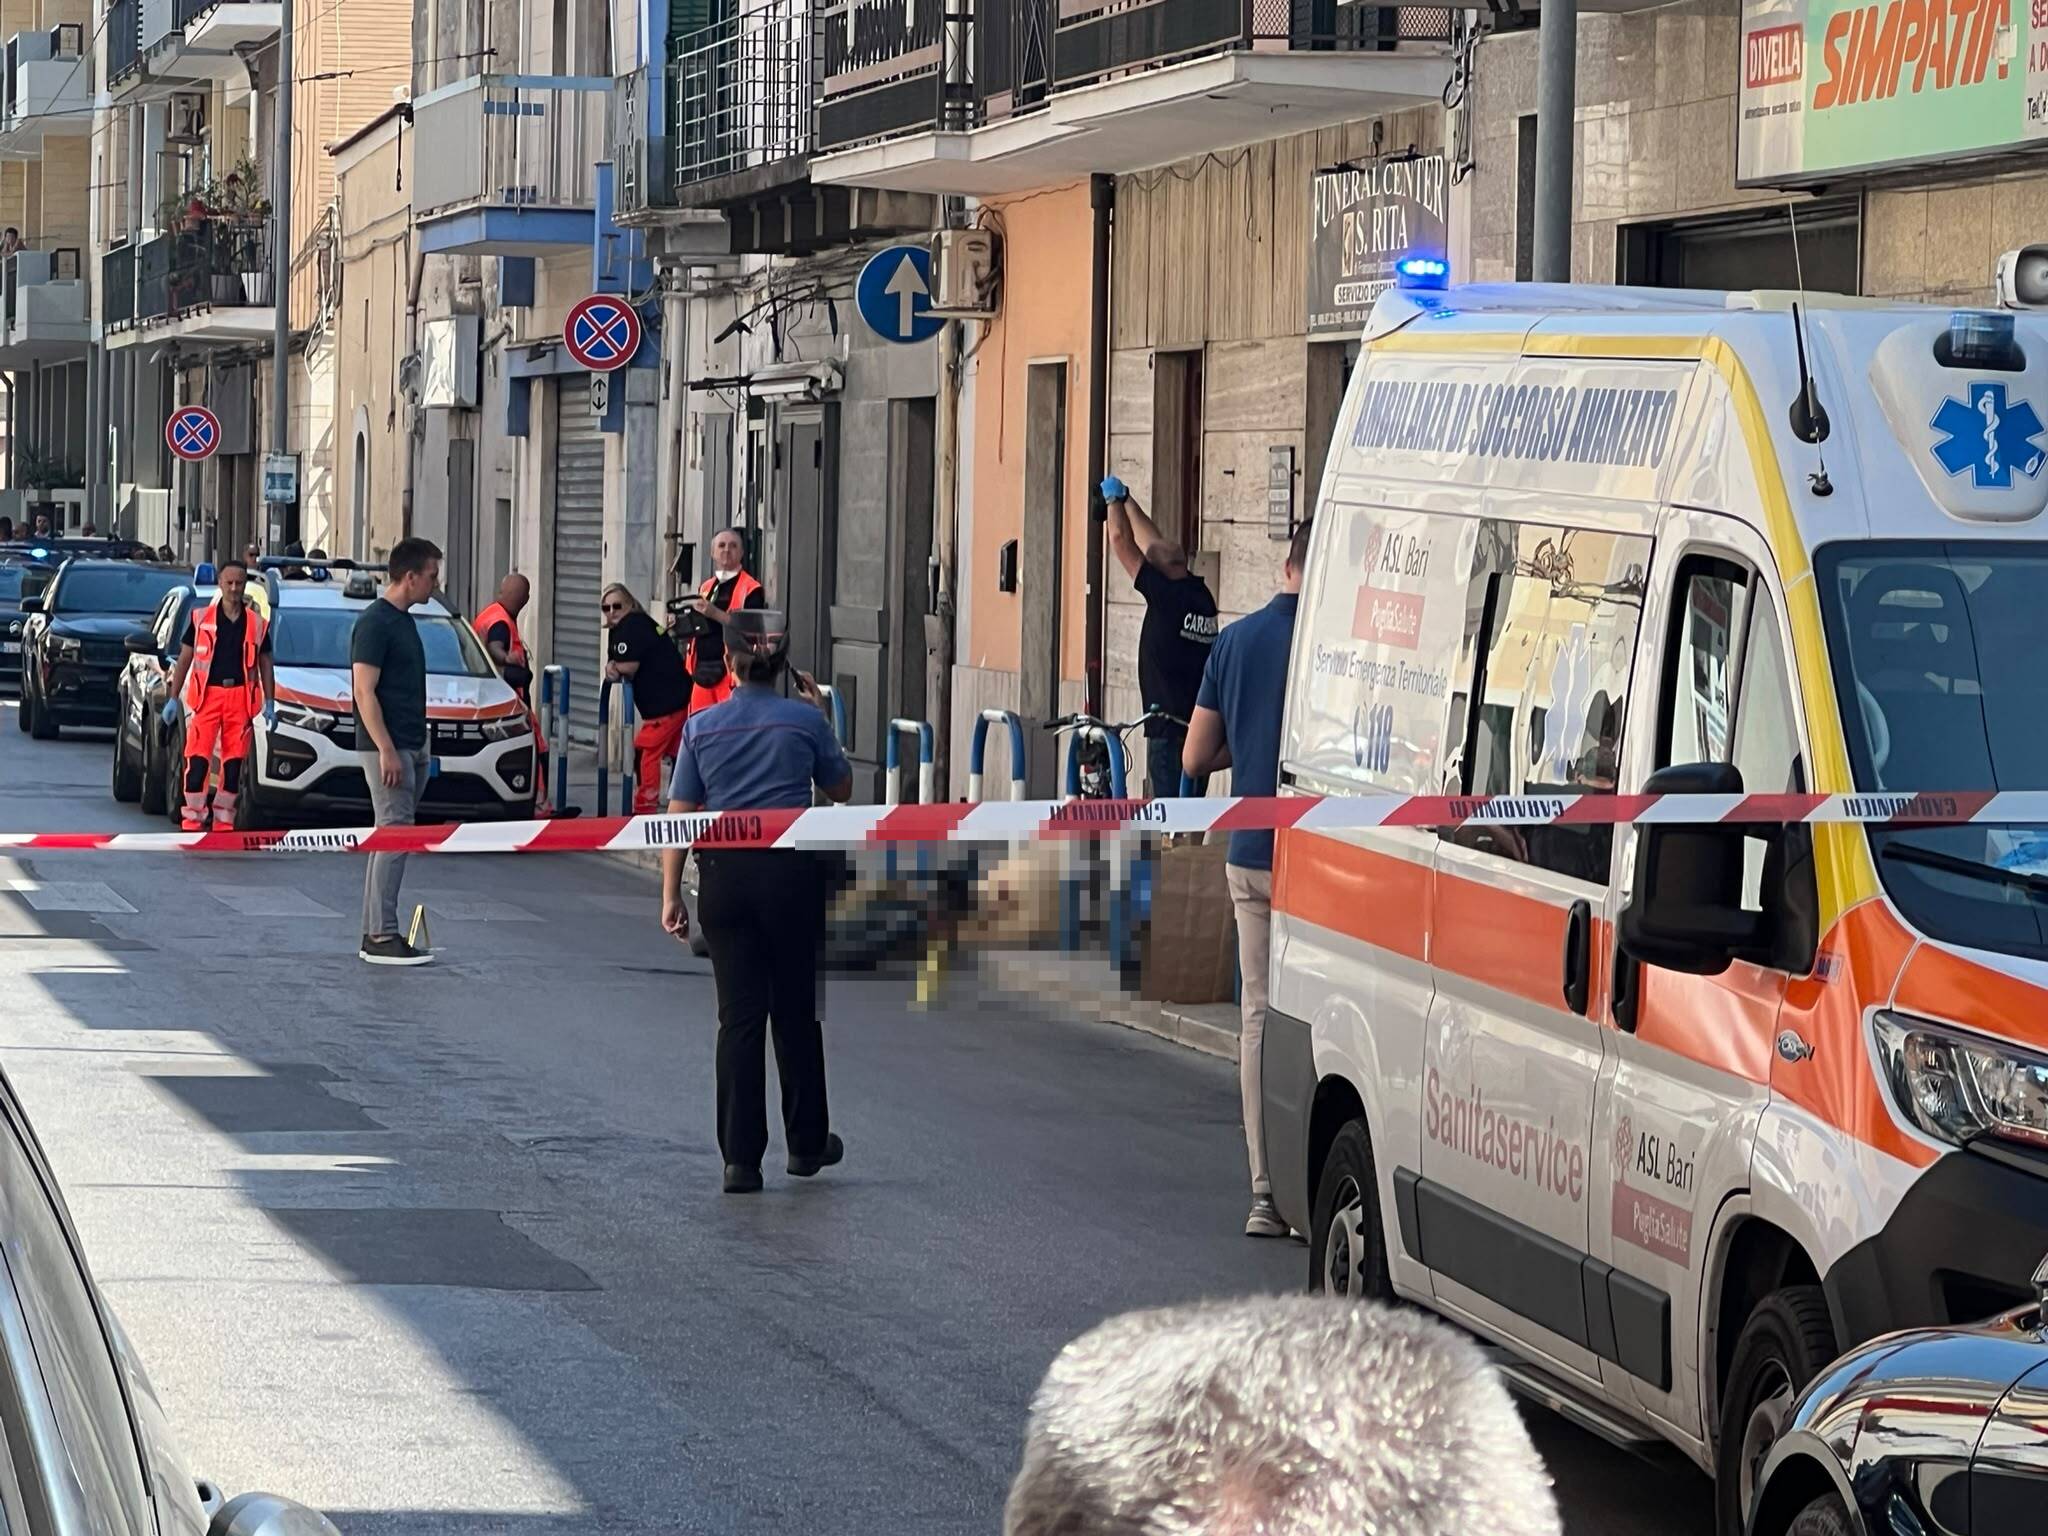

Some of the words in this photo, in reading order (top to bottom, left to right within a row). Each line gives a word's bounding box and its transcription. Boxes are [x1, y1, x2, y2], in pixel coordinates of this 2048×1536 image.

[1748, 30, 1801, 83] DIVELLA
[1312, 167, 1380, 243] FUNERAL
[1383, 154, 1444, 225] CENTER
[1355, 209, 1368, 256] S.
[1372, 203, 1409, 254] RITA
[1337, 283, 1369, 304] SERVIZIO
[1352, 380, 1457, 453] AMBULANZA
[1446, 382, 1479, 454] DI
[1468, 383, 1577, 462] SOCCORSO
[1565, 387, 1678, 470] AVANZATO
[1380, 533, 1402, 574] ASL
[1404, 535, 1432, 578] Bari
[1349, 650, 1397, 691] Emergenza
[1398, 660, 1448, 699] Territoriale
[645, 815, 762, 845] CARABINIERI
[1449, 799, 1565, 818] CARABINIERI
[1842, 797, 1957, 817] CARABINIERI
[1426, 1066, 1584, 1202] Sanitaservice
[1636, 1131, 1662, 1181] ASL
[1666, 1141, 1696, 1193] Bari
